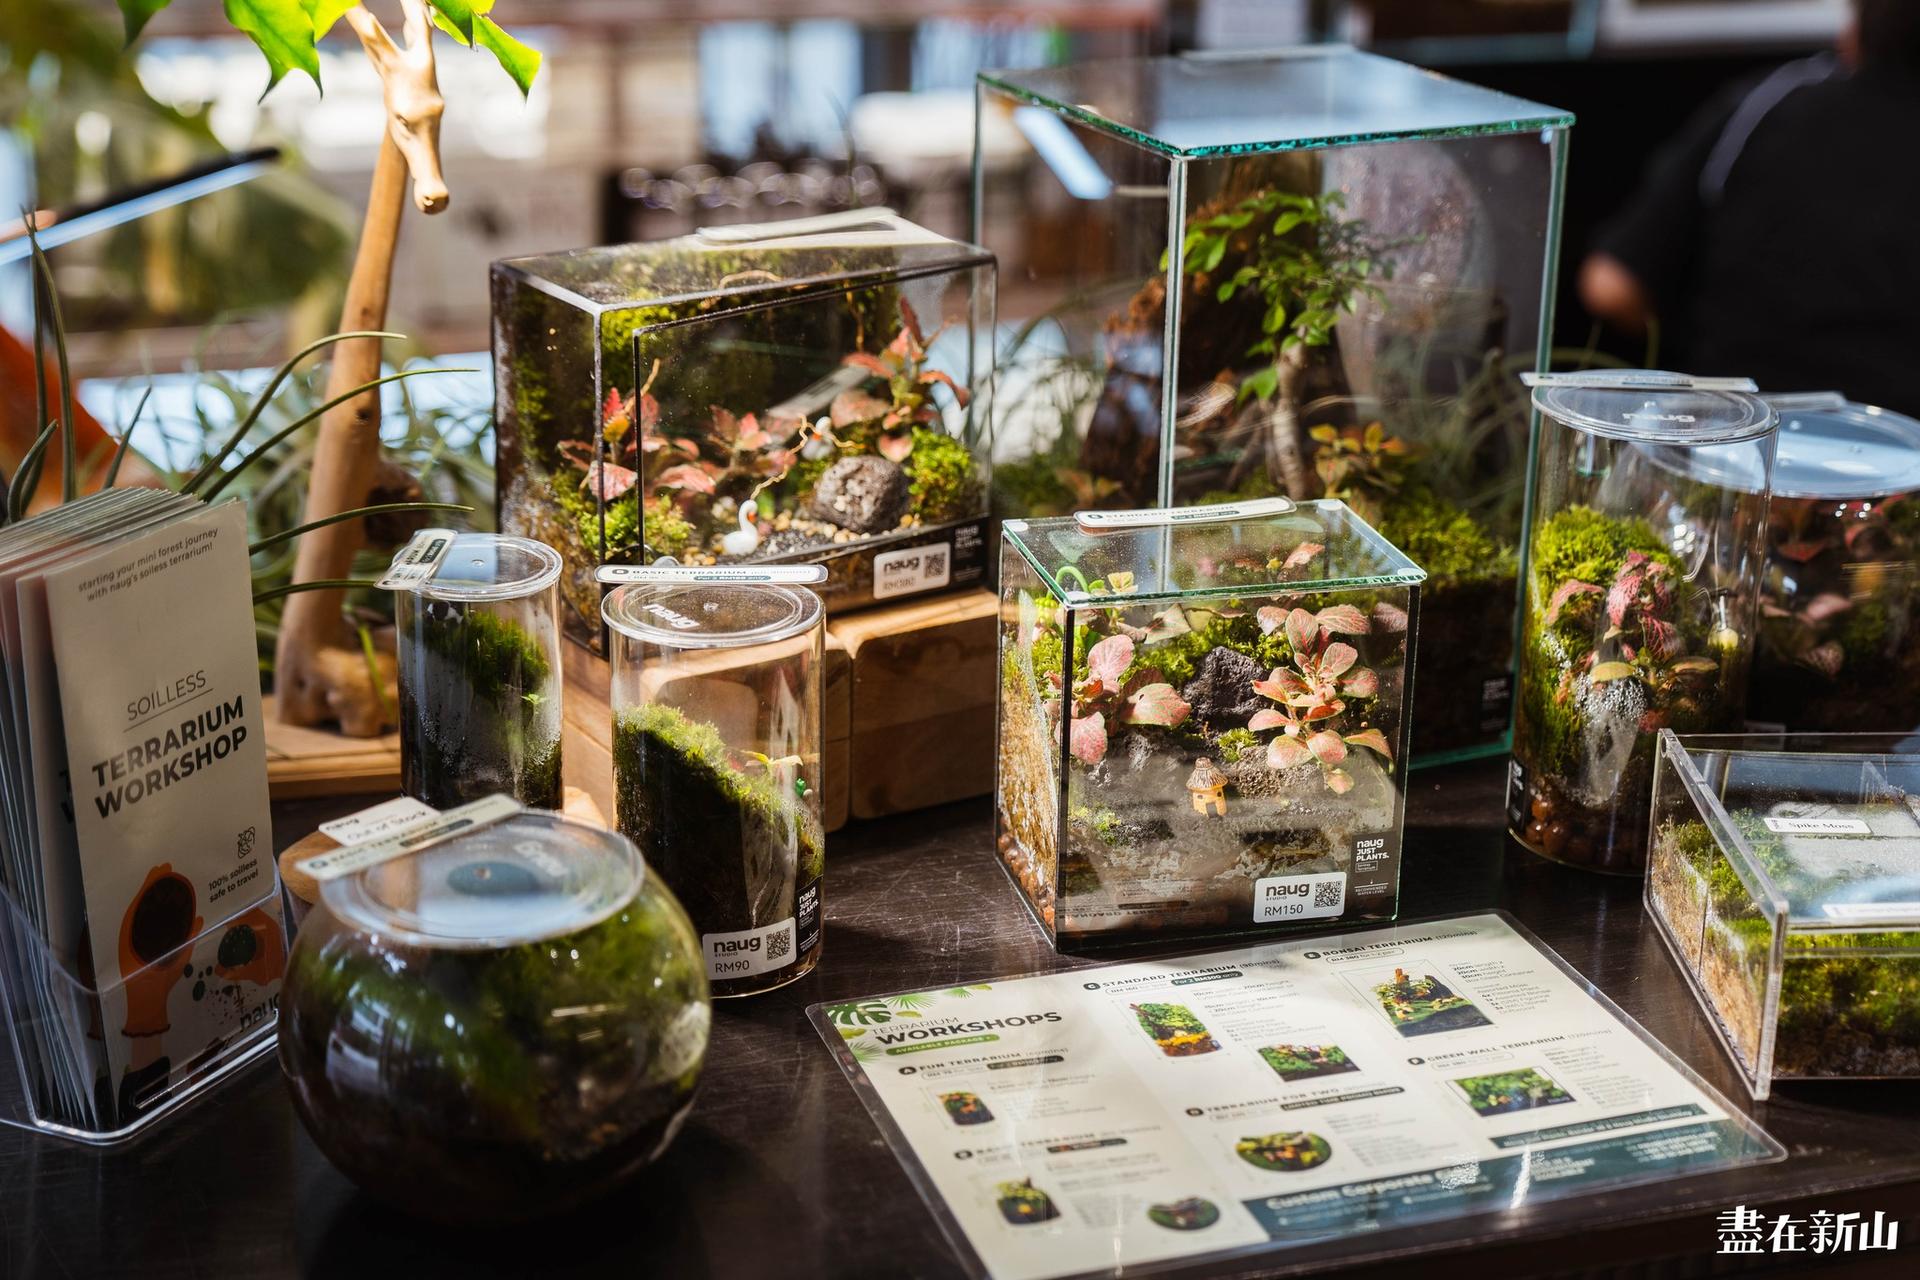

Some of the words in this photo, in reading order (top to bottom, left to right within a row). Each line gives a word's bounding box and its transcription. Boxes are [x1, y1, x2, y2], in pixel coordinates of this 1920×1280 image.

[79, 570, 115, 592] starting
[116, 562, 135, 578] your
[137, 552, 157, 567] mini
[158, 541, 184, 557] forest
[184, 528, 218, 549] journey
[884, 556, 920, 574] naug
[88, 587, 108, 602] with
[110, 574, 138, 593] naug's
[169, 542, 212, 566] terrarium!
[127, 670, 206, 721] SOILLESS
[92, 696, 244, 787] TERRARIUM
[94, 726, 247, 819] WORKSHOP
[1356, 848, 1376, 856] JUST
[1357, 839, 1384, 848] naug
[1356, 852, 1389, 862] PLANTS.
[209, 874, 229, 891] 100%
[210, 889, 225, 903] safe
[227, 883, 235, 892] to
[237, 868, 258, 887] travel
[1266, 883, 1310, 897] naug
[800, 886, 816, 903] naug
[1265, 904, 1303, 916] RM150
[714, 937, 761, 952] naug
[1324, 947, 1366, 955] BONSAI
[1370, 938, 1434, 948] TERRARIUM
[715, 960, 750, 973] RM90
[1102, 975, 1166, 987] STANDARD
[1170, 965, 1238, 977] TERRARIUM
[872, 1018, 959, 1034] TERRARIUM
[877, 1011, 1064, 1045] WORKSHOPS
[1501, 1037, 1566, 1049] TERRARIUM
[950, 1053, 1022, 1066] TERRARIUM
